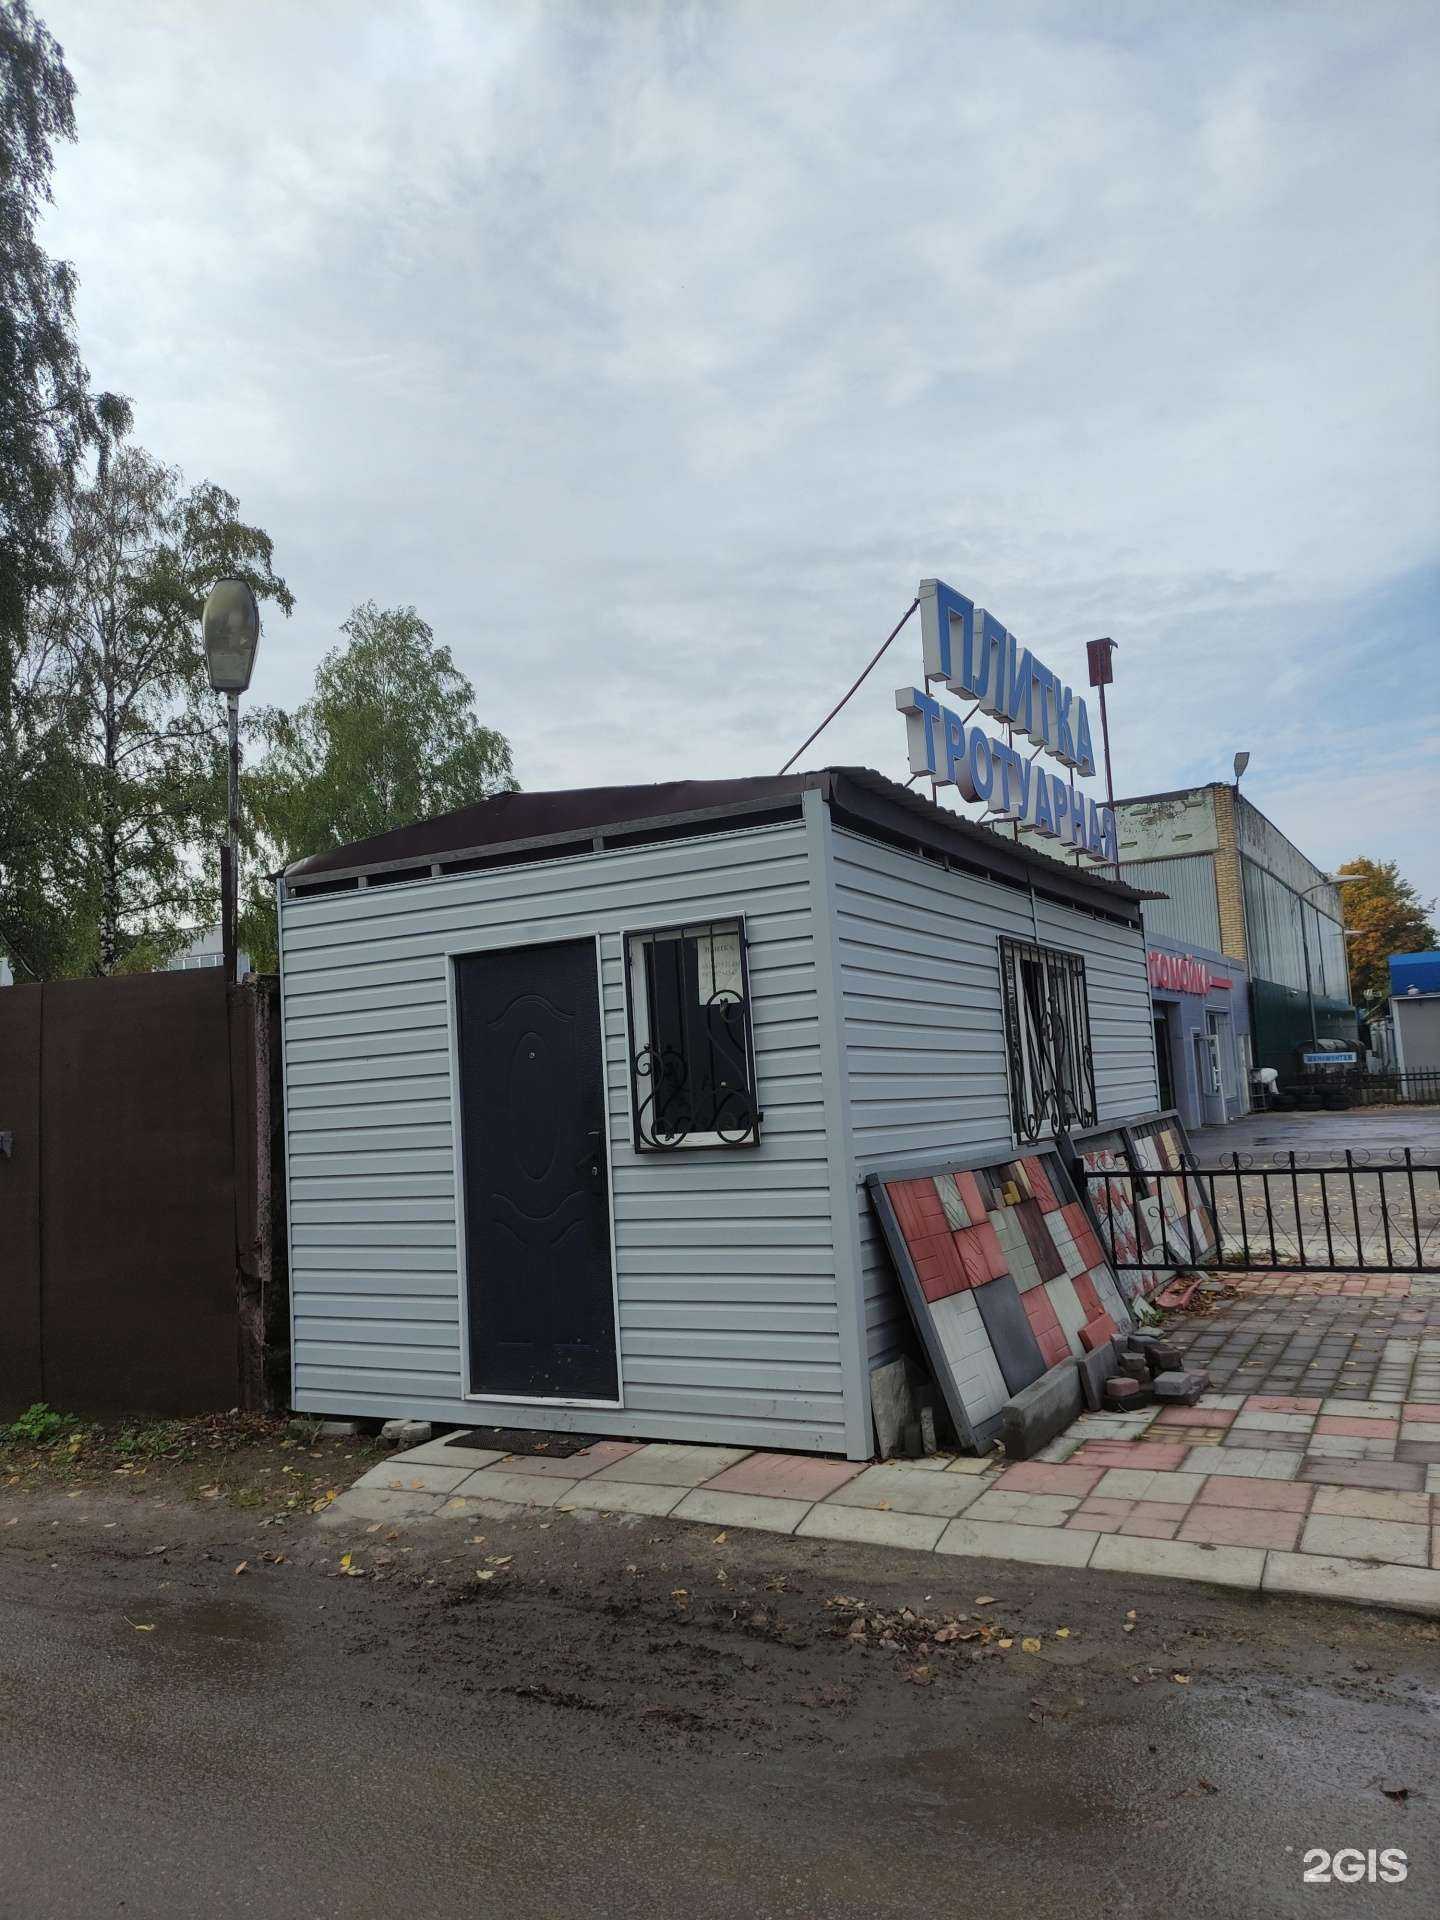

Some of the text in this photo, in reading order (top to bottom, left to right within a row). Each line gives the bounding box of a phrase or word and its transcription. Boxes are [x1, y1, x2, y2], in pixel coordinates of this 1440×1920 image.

[920, 579, 1096, 776] ПЛИТКА
[896, 687, 1117, 863] ТРОТУАРНАЯ
[1148, 951, 1209, 994] ТОМОЙКА
